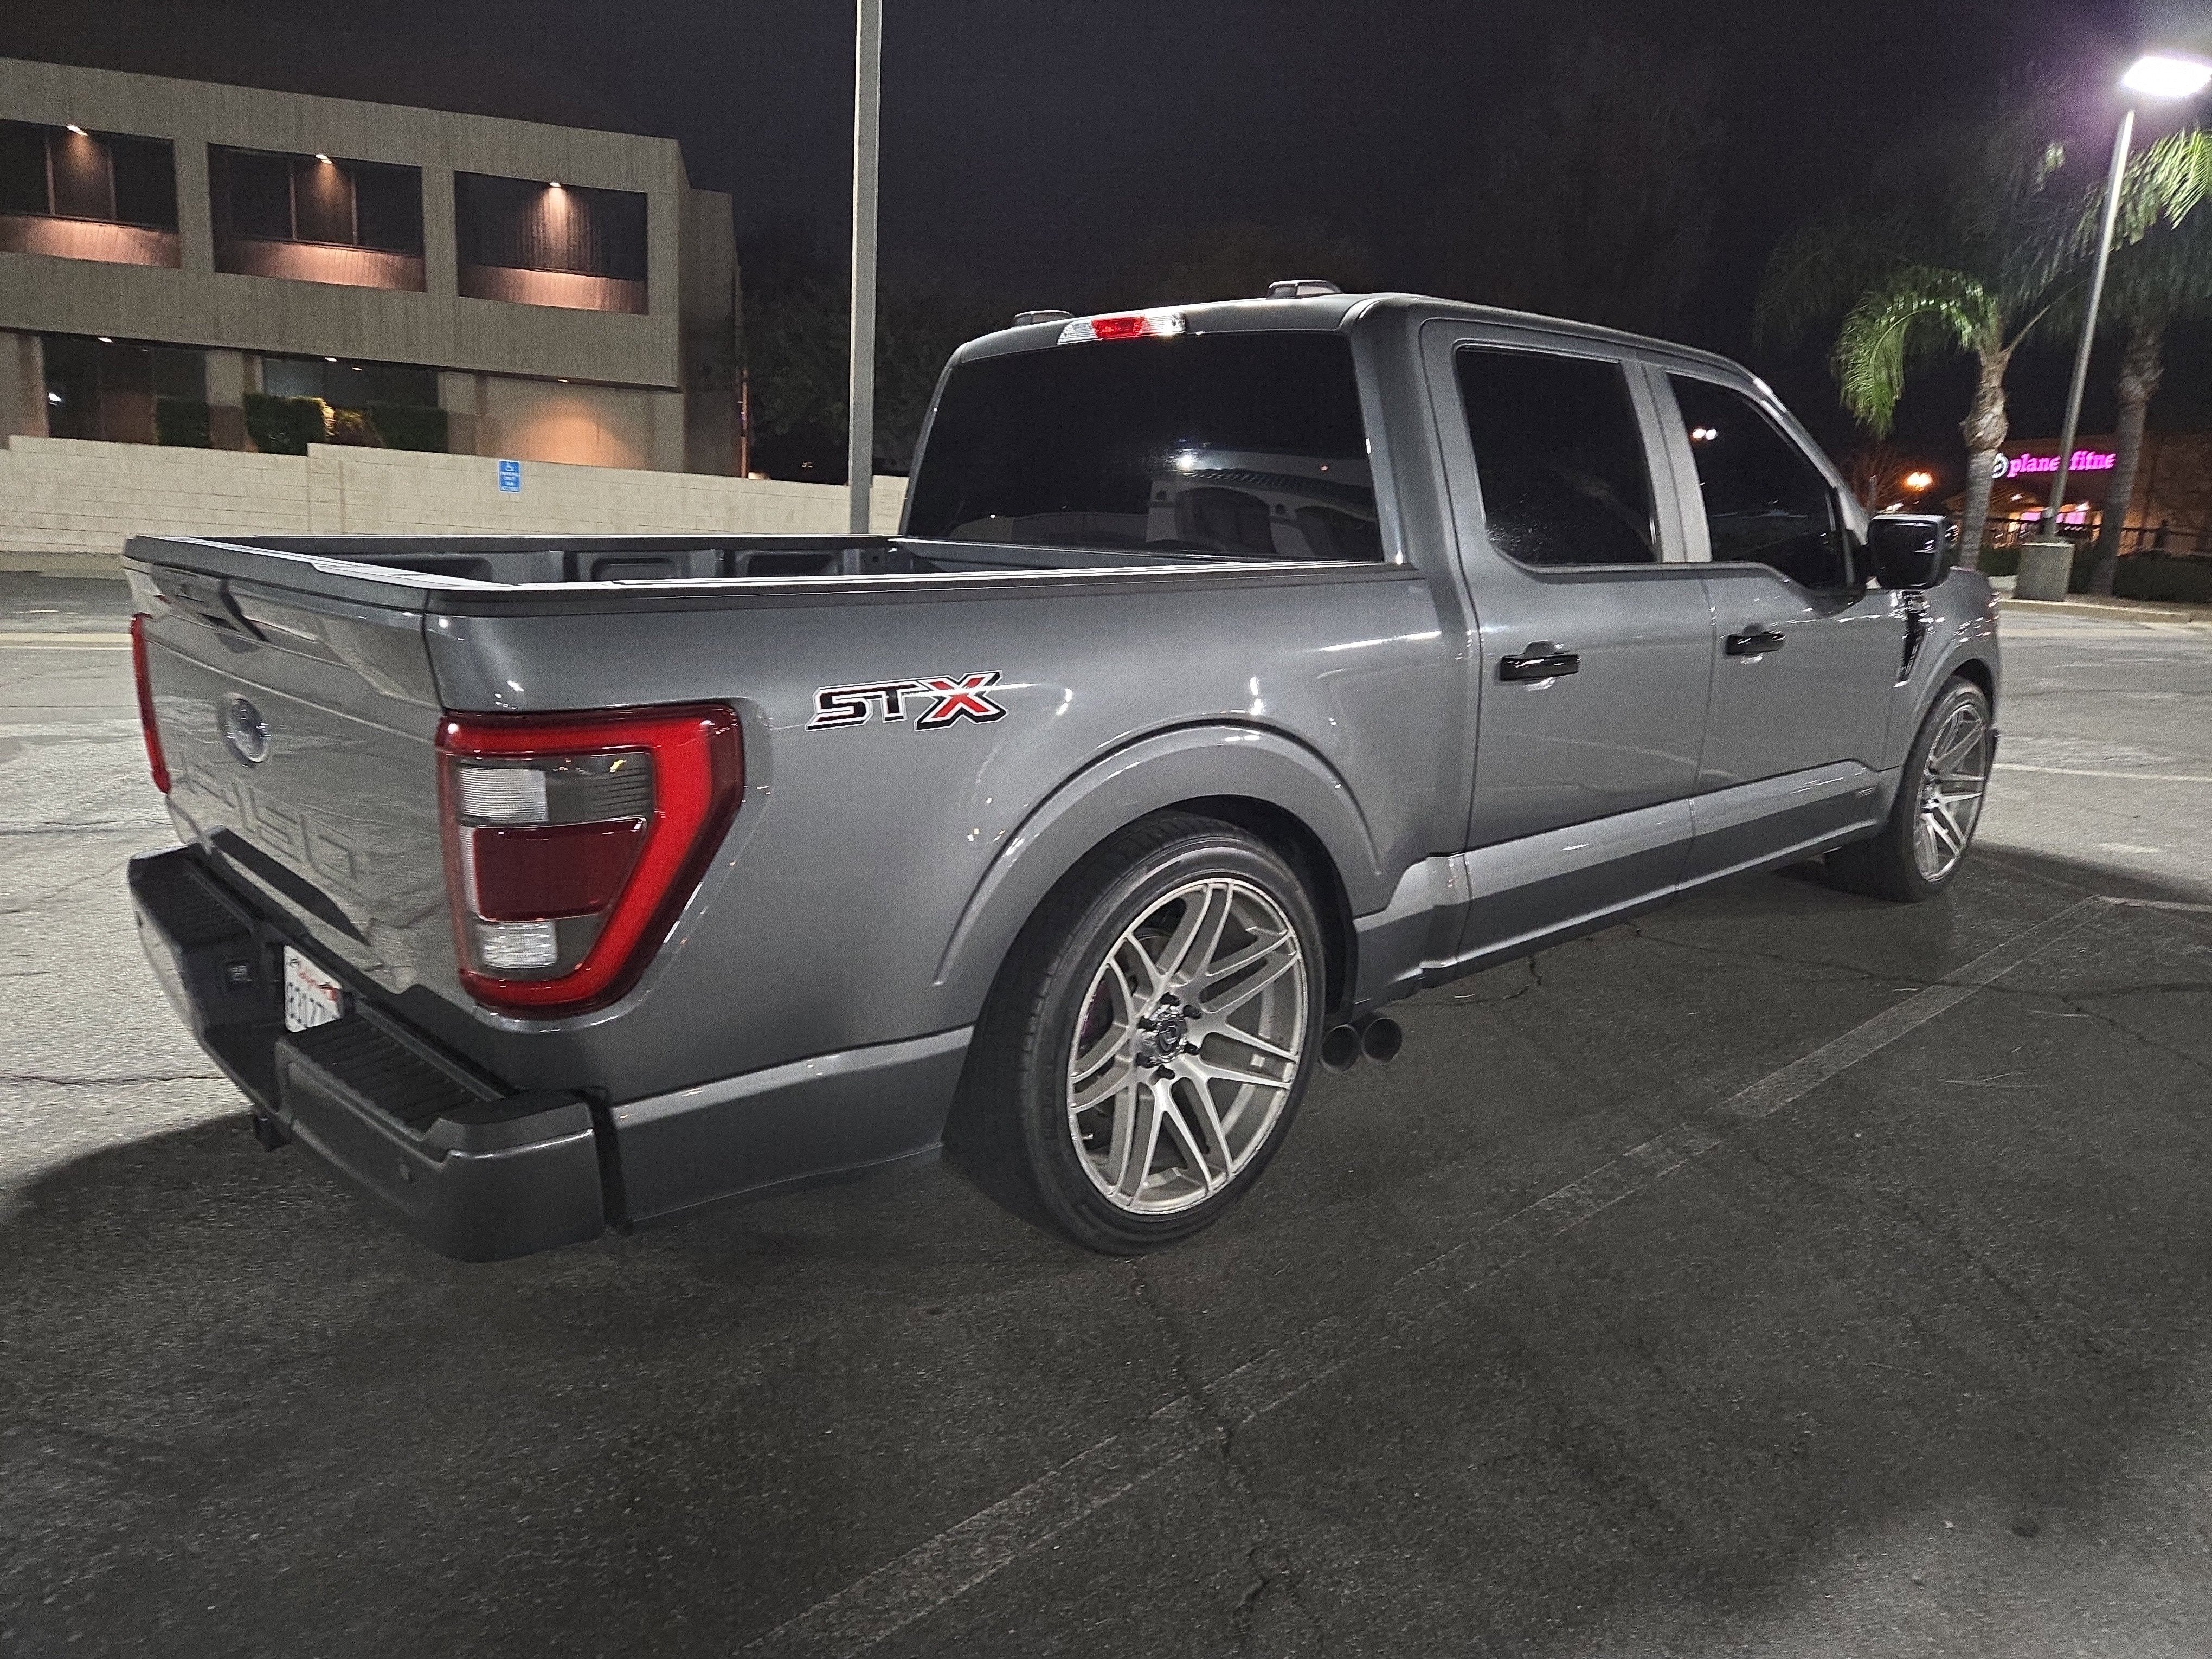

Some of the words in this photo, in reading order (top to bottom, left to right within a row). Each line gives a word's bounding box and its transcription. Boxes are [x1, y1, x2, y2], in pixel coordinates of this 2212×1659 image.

[2006, 453, 2061, 478] plane
[2068, 451, 2117, 471] fitne
[805, 670, 1009, 732] STX
